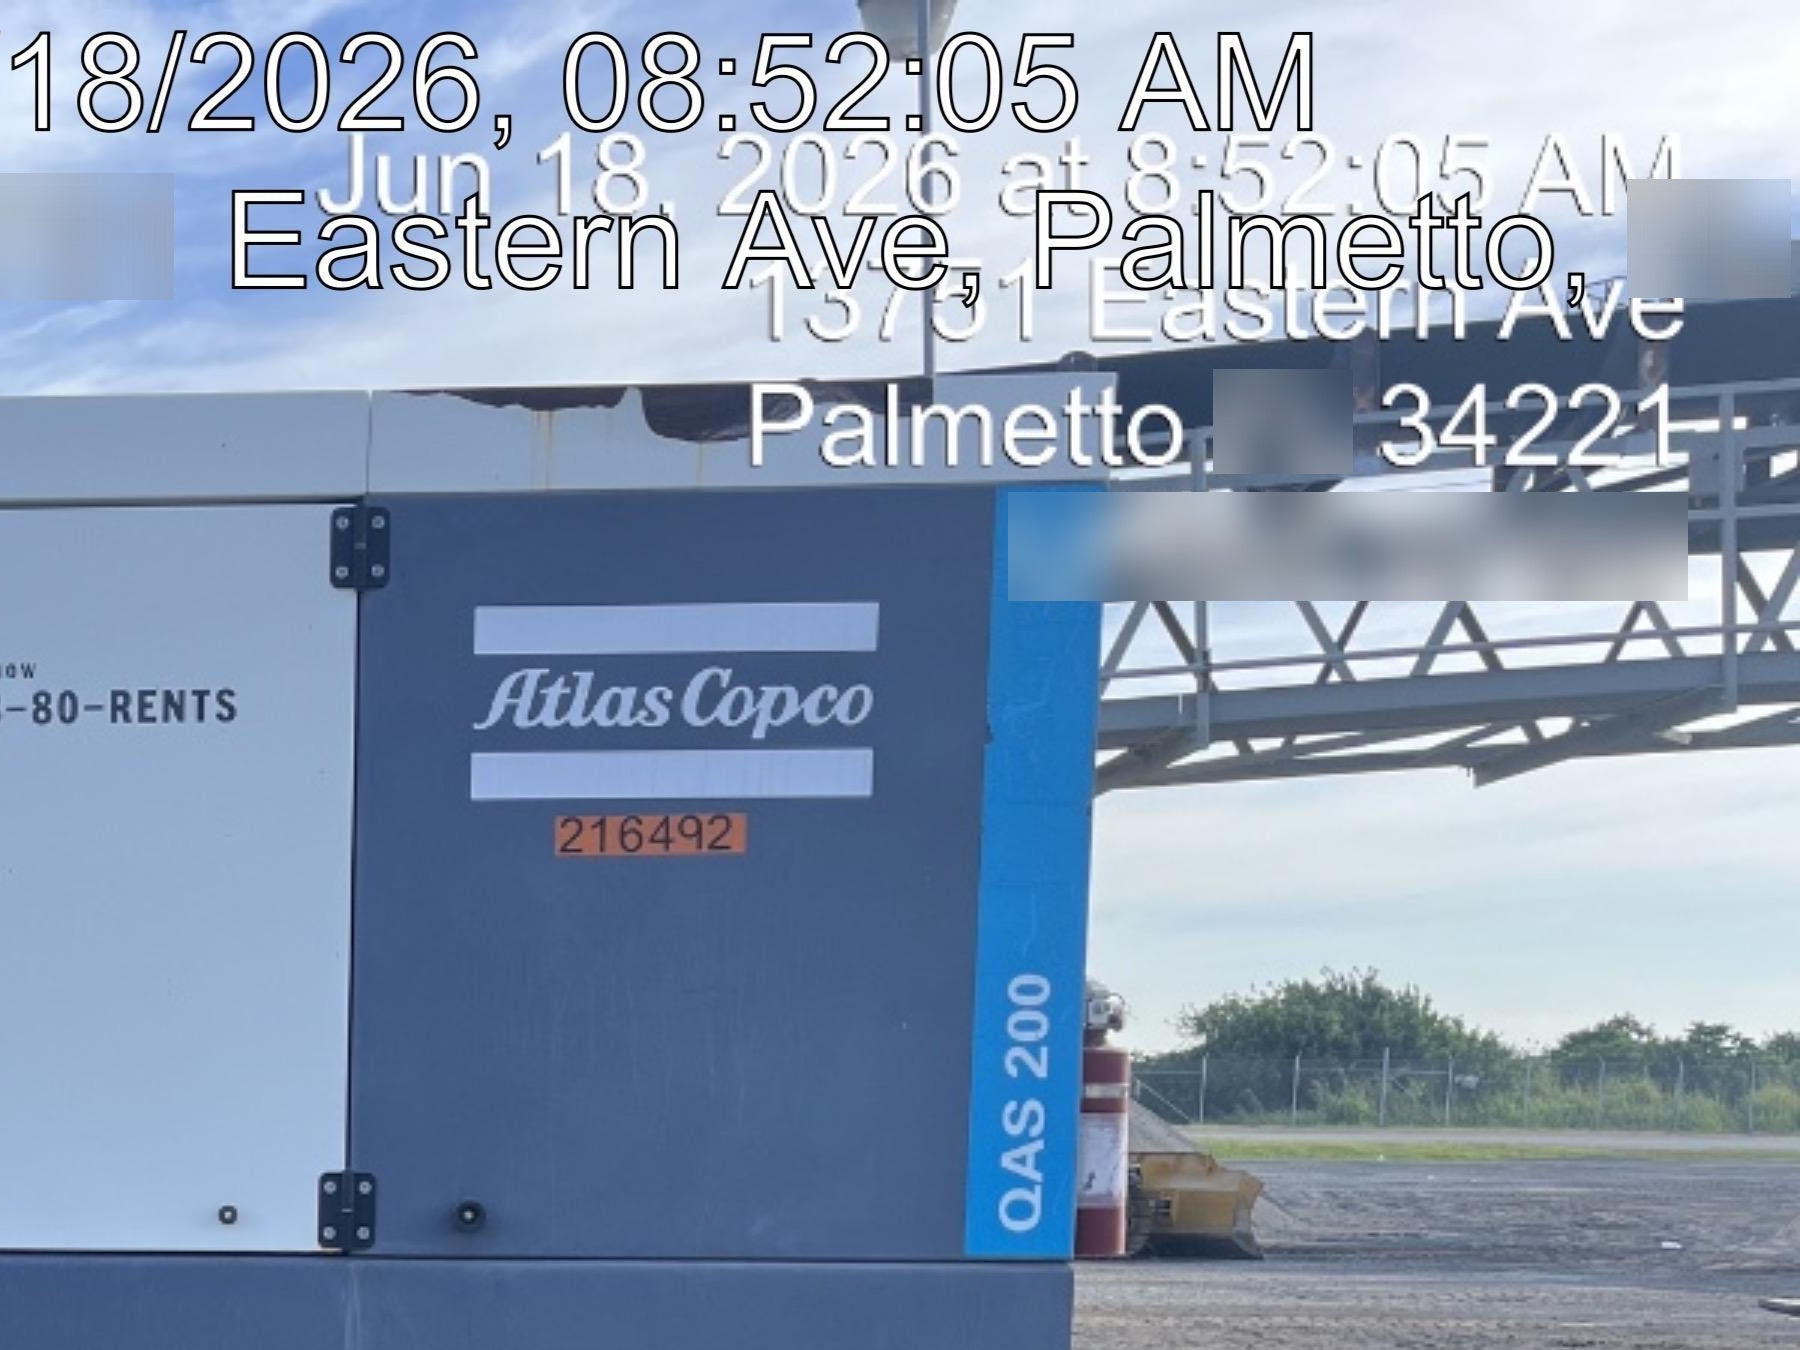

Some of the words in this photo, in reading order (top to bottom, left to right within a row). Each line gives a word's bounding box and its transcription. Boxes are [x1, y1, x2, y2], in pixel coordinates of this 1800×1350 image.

[473, 667, 673, 729] Atlas
[680, 666, 873, 739] Copco
[559, 814, 732, 853] 216492
[1004, 974, 1051, 1078] 200
[999, 1099, 1045, 1232] QAS
